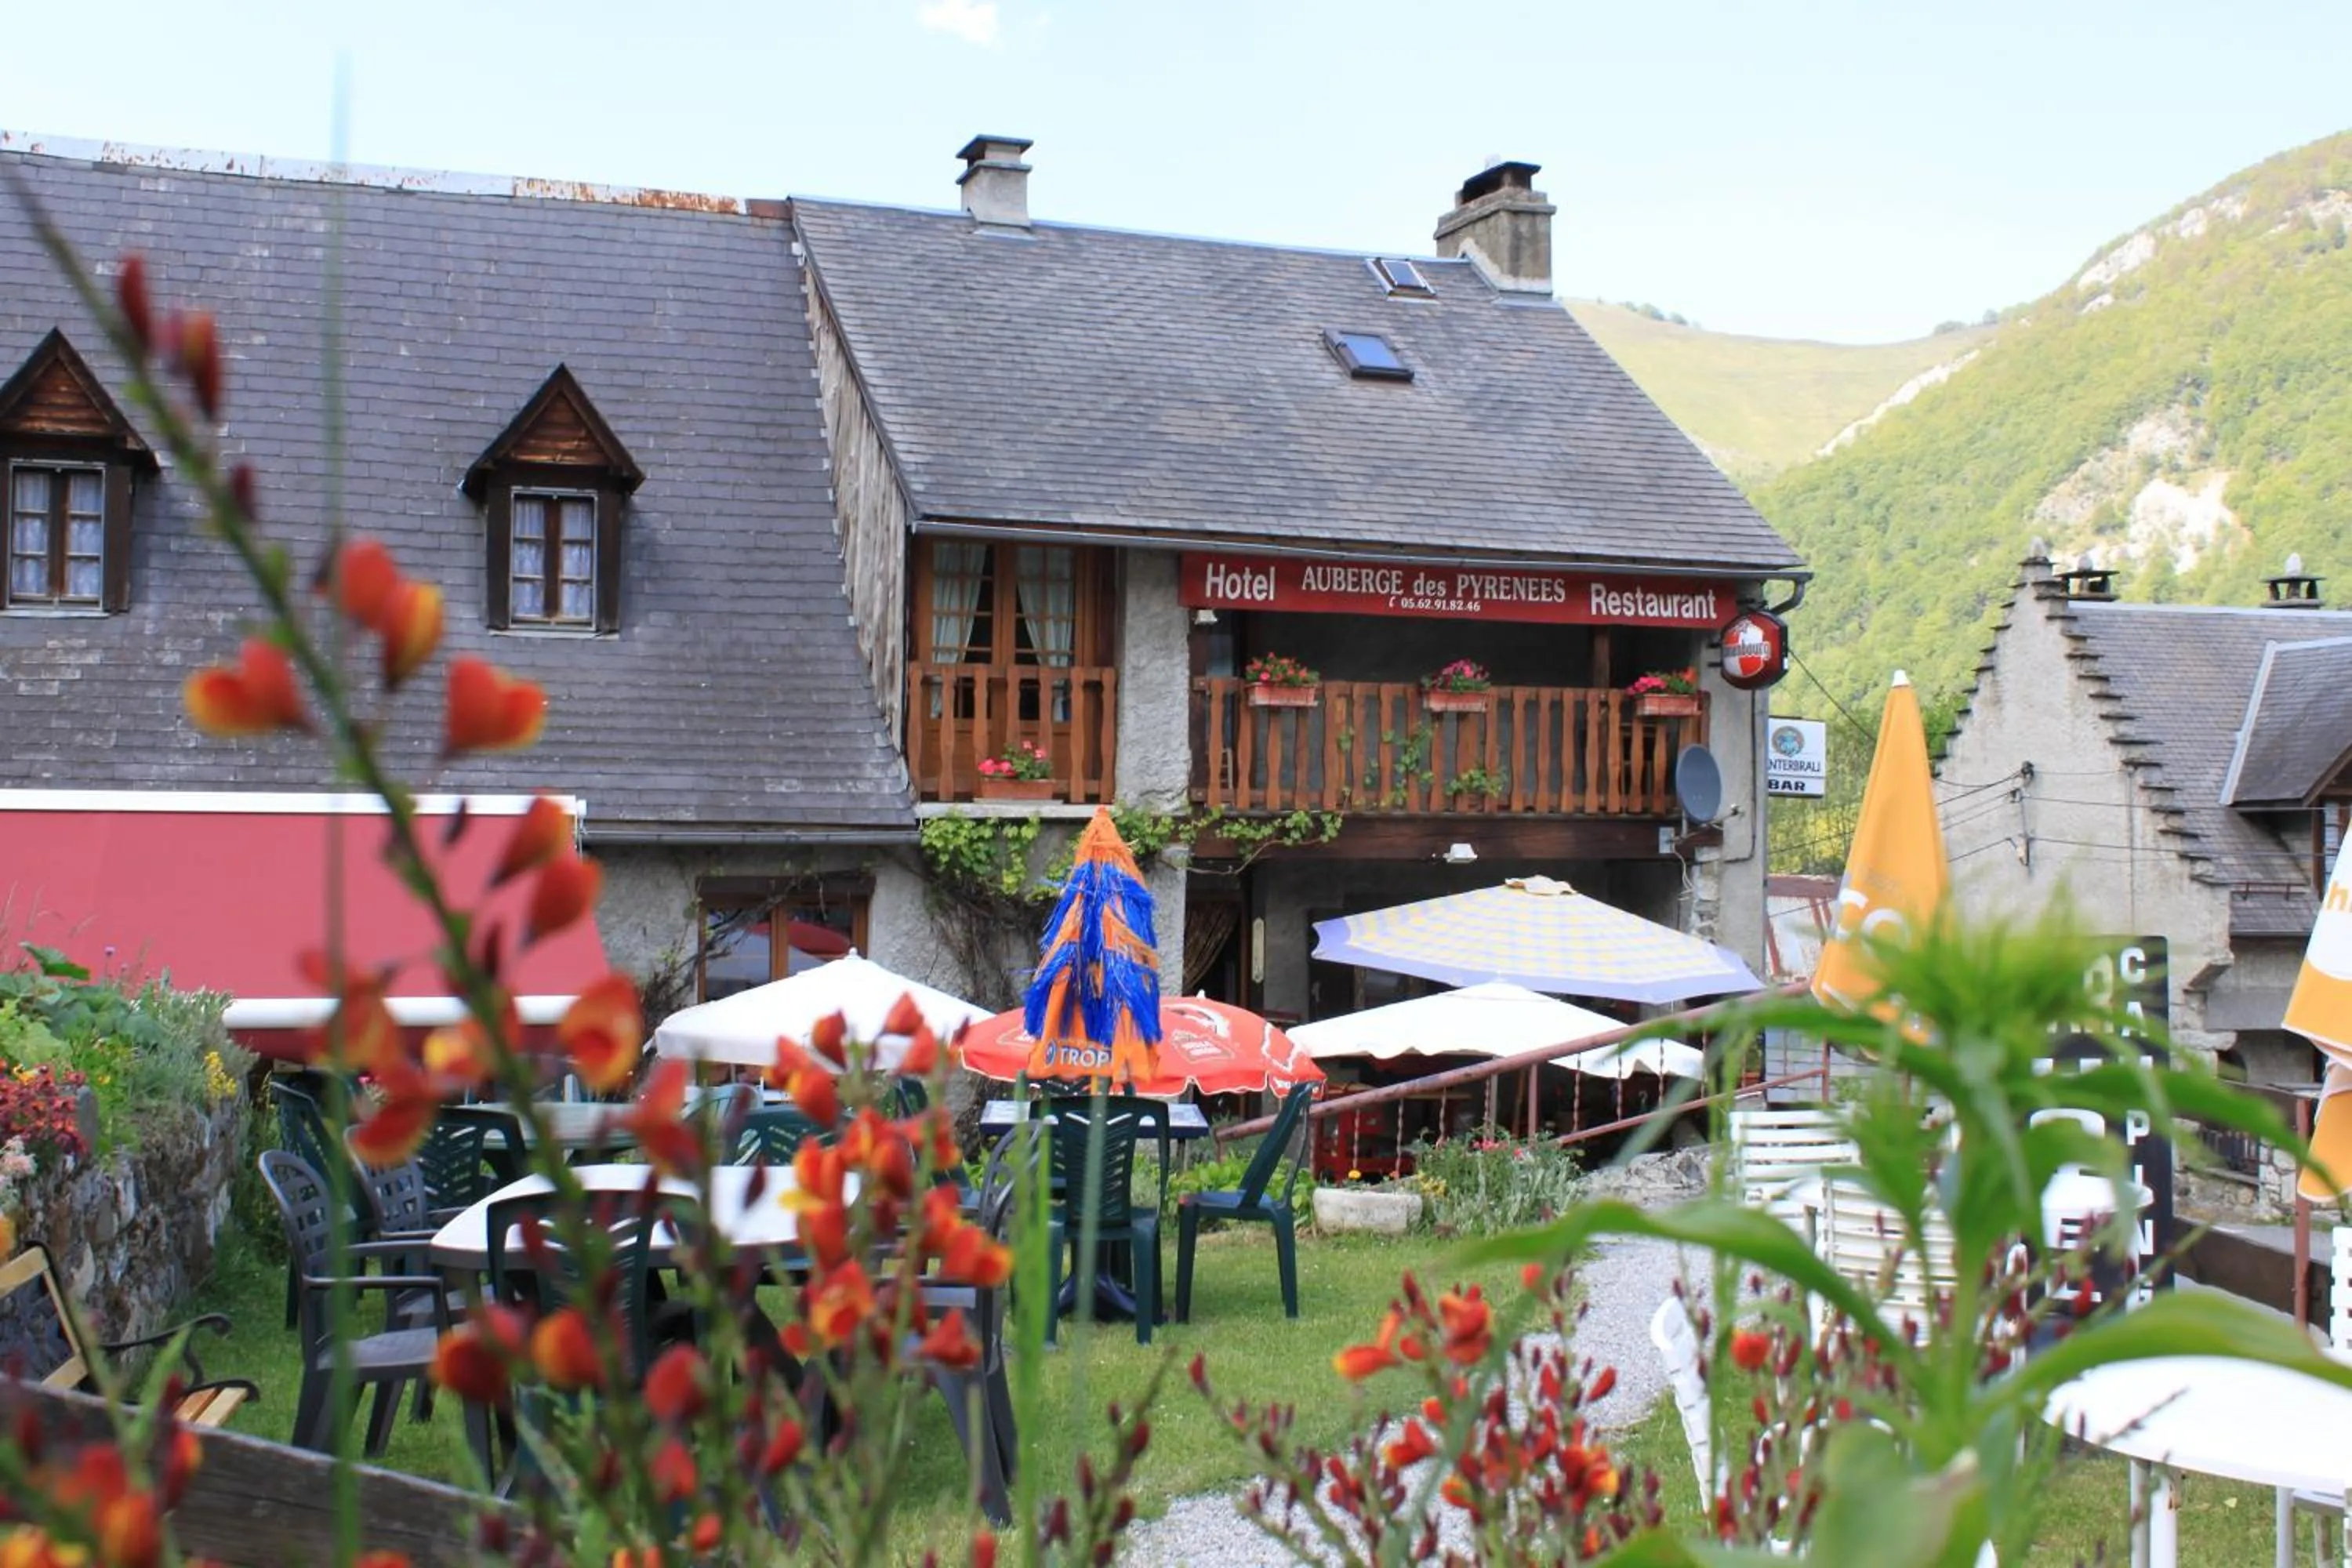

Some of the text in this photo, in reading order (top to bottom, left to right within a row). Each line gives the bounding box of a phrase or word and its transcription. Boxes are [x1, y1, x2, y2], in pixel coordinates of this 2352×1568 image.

[1204, 562, 1717, 619] Hotel AUBERGE des PYRENEES Restaurant
[1768, 779, 1806, 791] BAR
